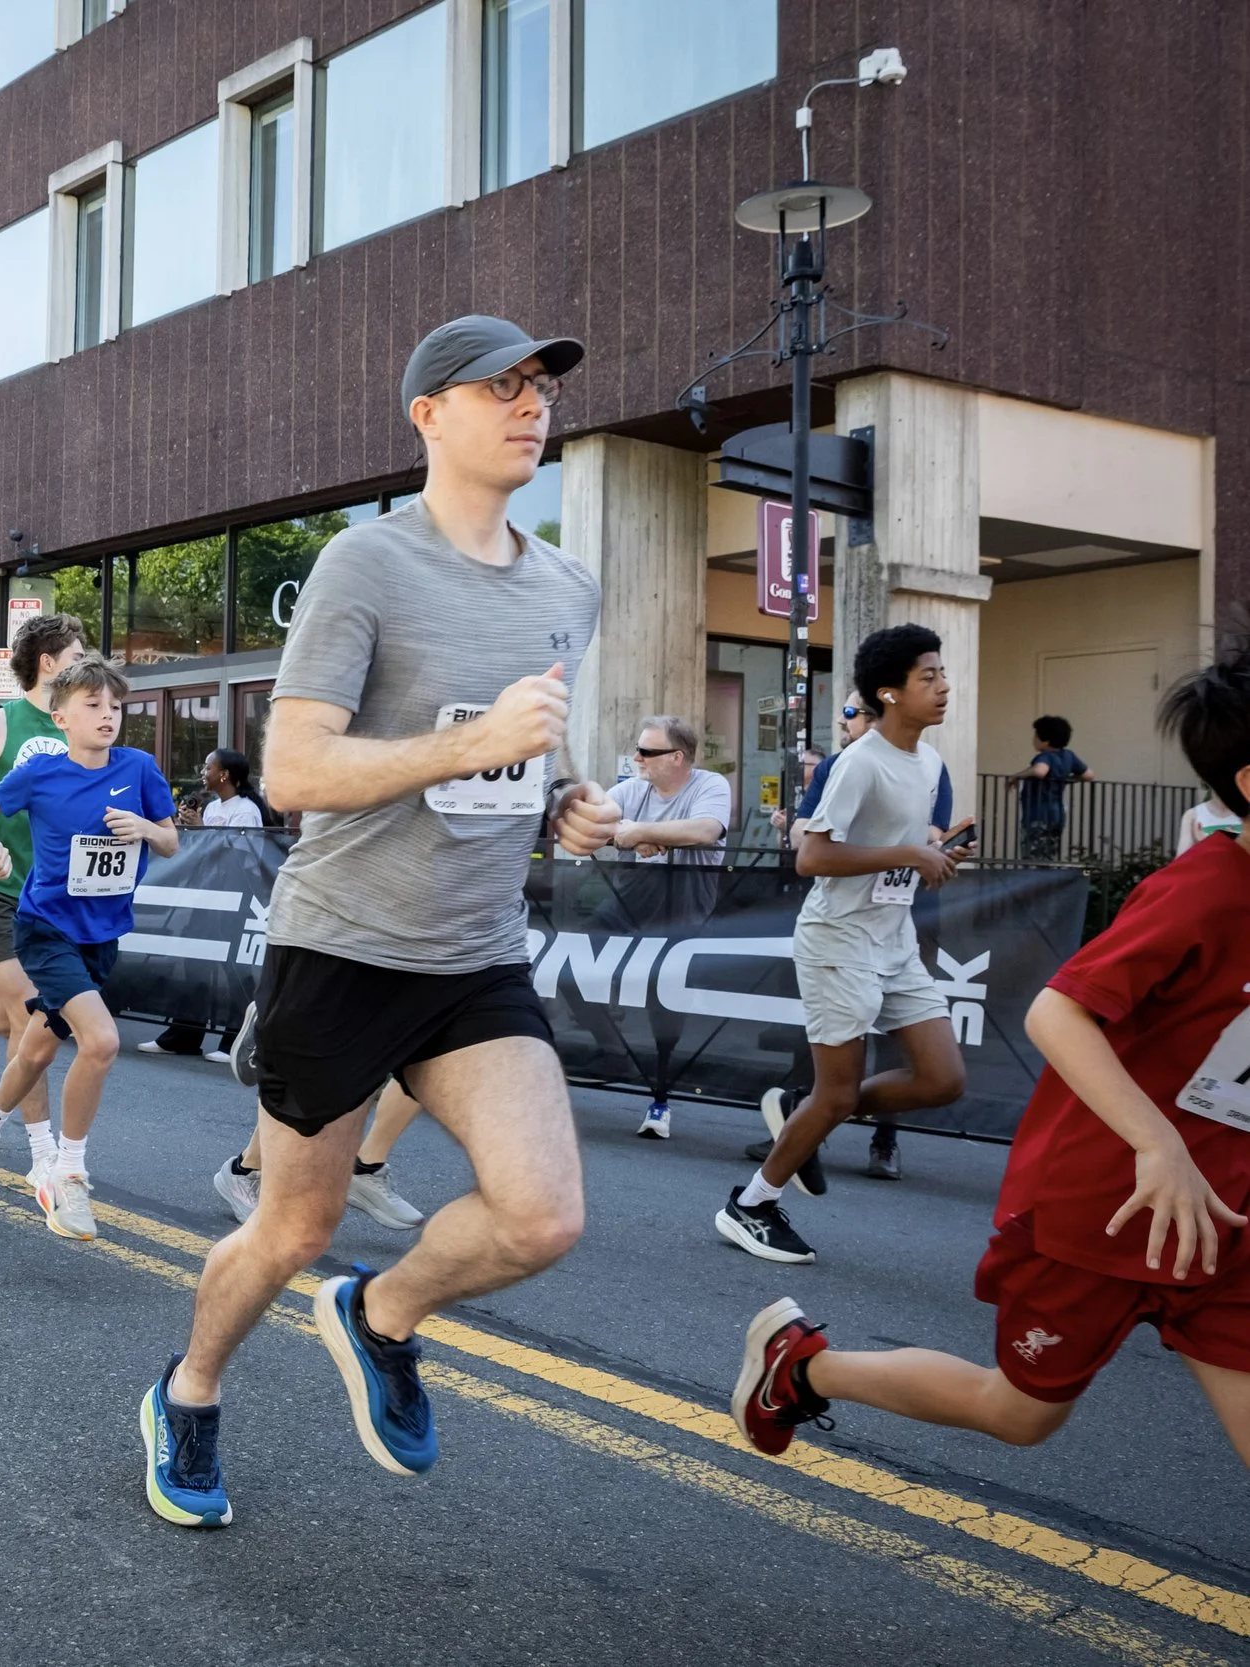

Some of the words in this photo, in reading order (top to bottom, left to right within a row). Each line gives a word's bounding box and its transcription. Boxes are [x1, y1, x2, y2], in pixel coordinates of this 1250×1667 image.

[434, 800, 457, 809] FOOD
[472, 801, 498, 810] DRINK
[510, 802, 536, 810] DRINK
[79, 837, 127, 847] BIONIC
[85, 850, 127, 877] 783
[1188, 1094, 1215, 1110] FOOD
